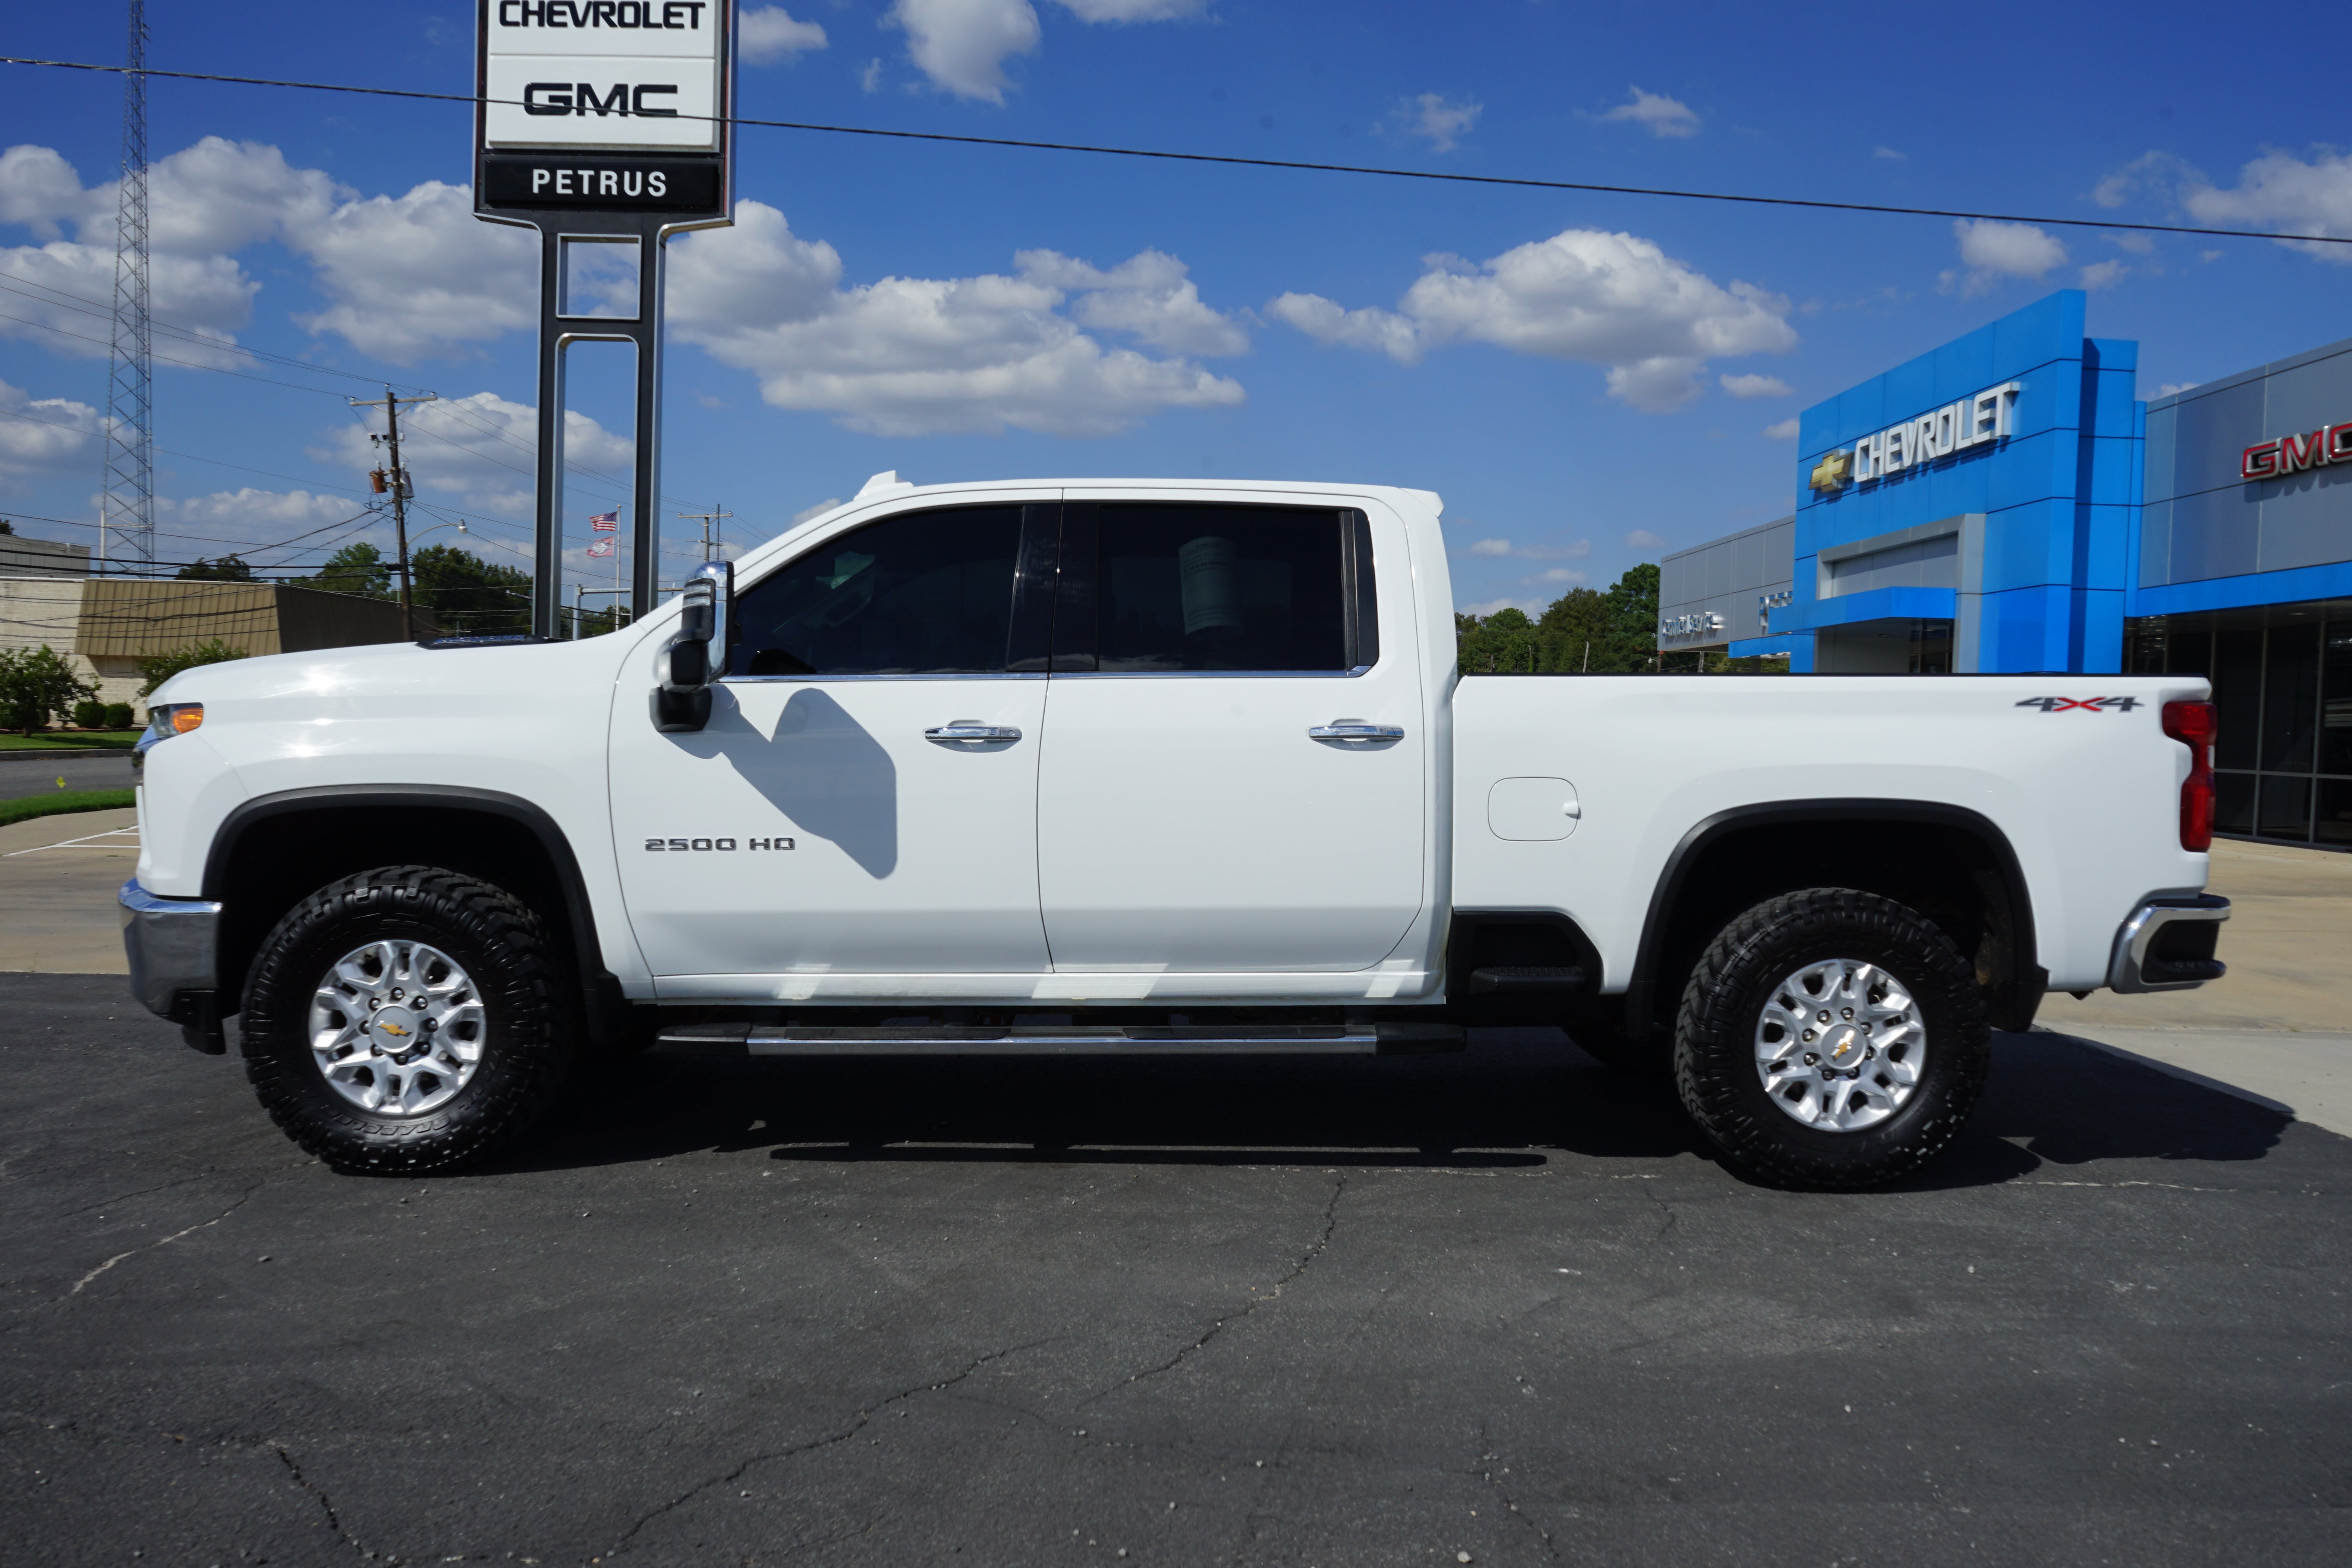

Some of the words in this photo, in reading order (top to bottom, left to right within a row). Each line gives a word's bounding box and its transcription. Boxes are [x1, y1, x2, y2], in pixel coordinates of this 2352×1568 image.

[499, 0, 706, 29] CHEVROLET
[524, 82, 678, 118] GMC
[532, 169, 667, 197] PETRUS
[1854, 381, 2020, 483] CHEVROLET
[644, 837, 737, 851] 2500
[749, 837, 795, 851] HD
